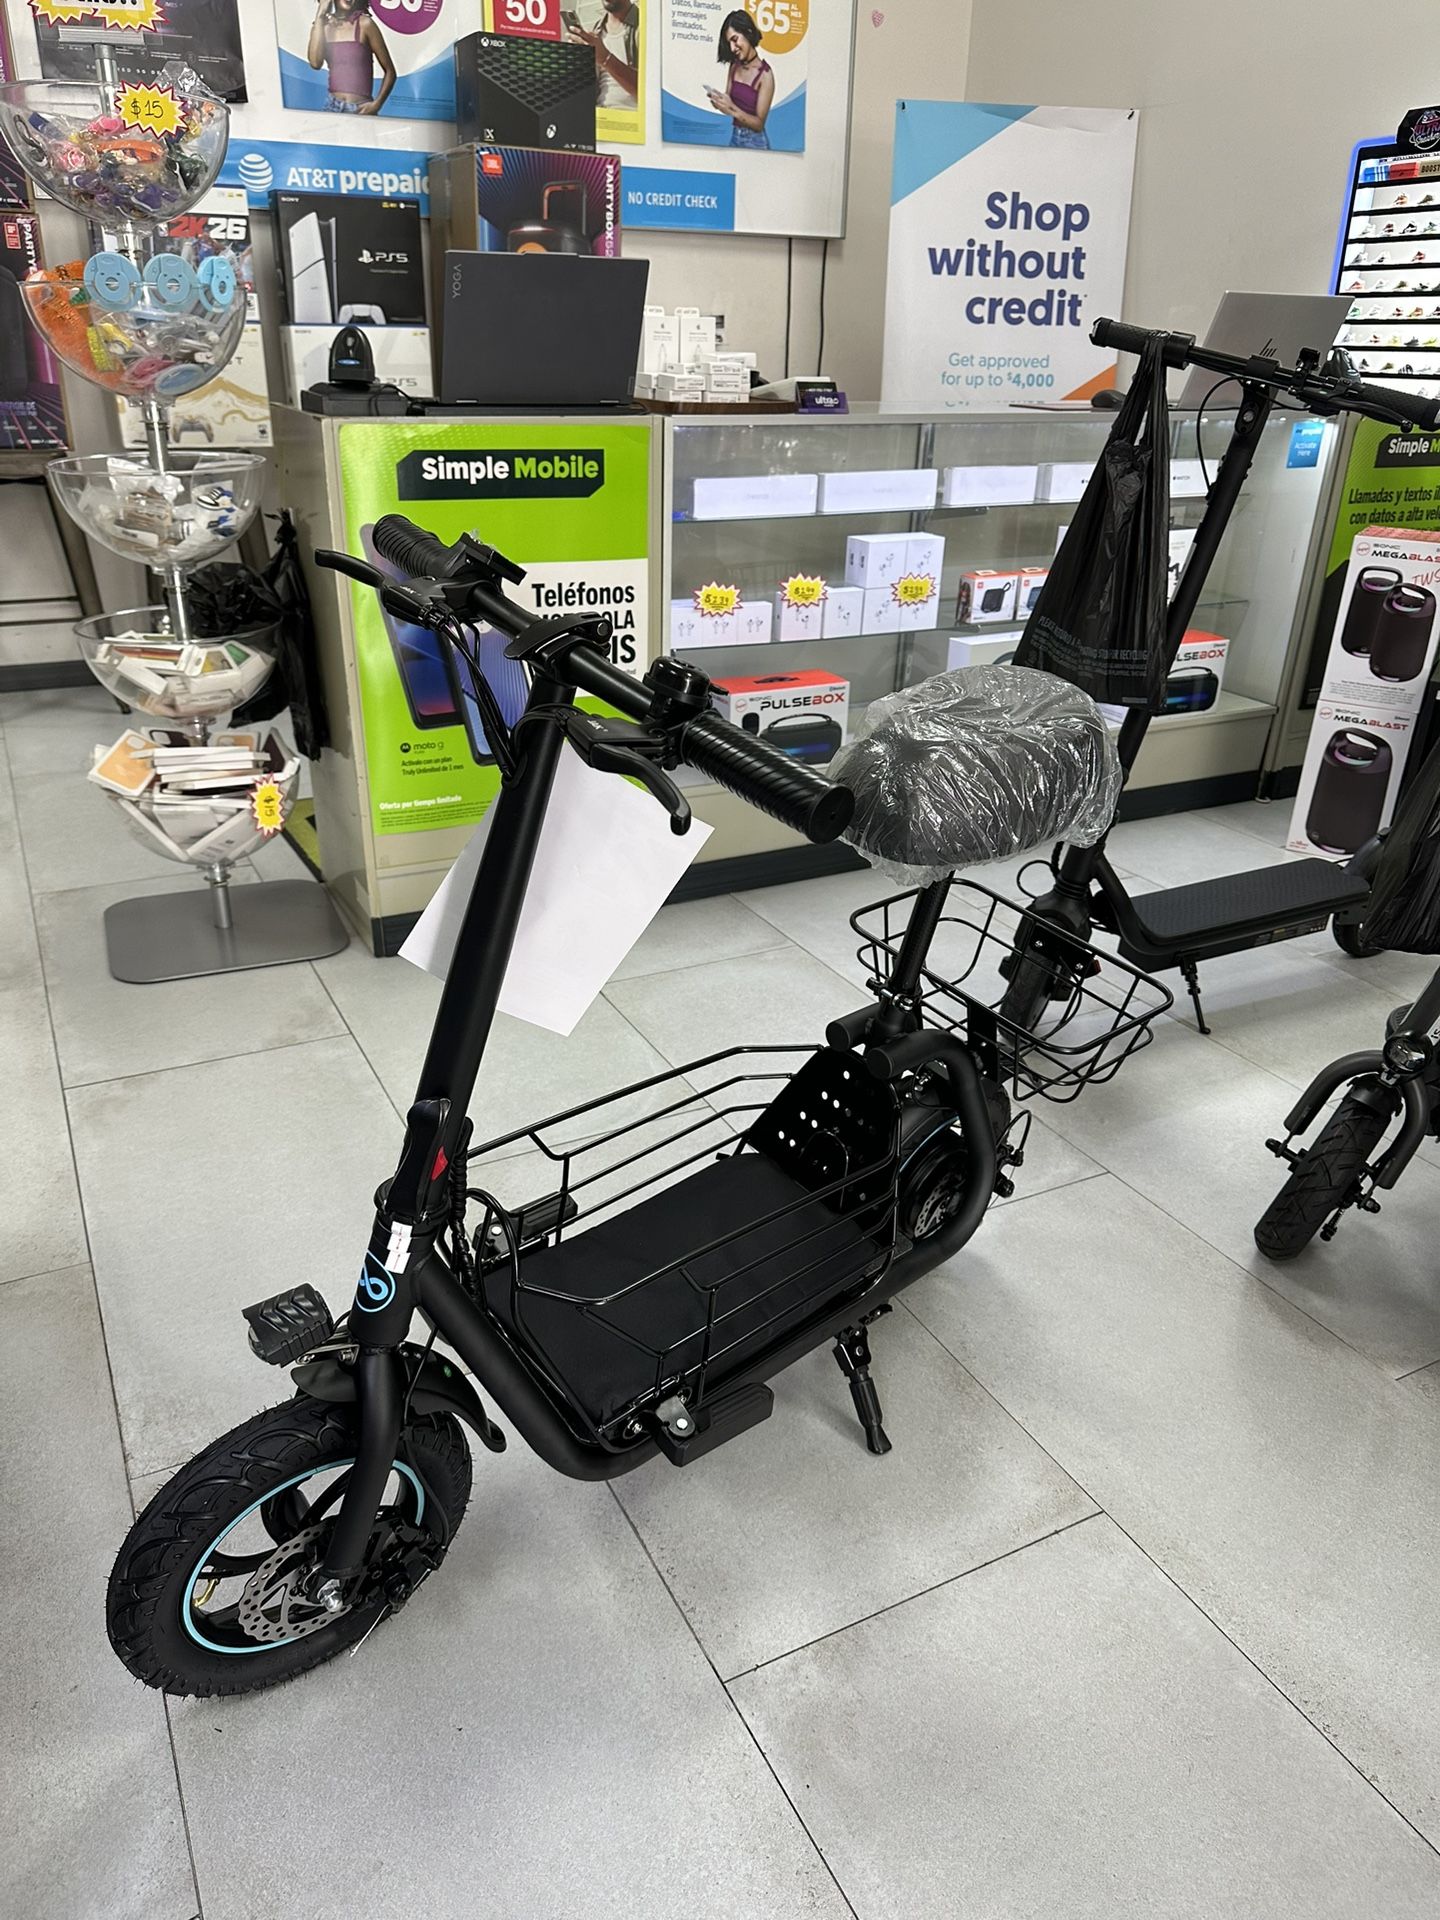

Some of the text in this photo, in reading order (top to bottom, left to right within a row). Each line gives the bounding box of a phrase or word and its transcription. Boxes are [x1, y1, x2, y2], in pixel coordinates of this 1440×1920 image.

[130, 100, 163, 119] $15
[287, 167, 334, 189] AT&T
[627, 191, 718, 209] NO CREDIT CHECK
[984, 191, 1090, 241] Shop
[375, 251, 409, 264] PS5
[927, 237, 1087, 280] without
[452, 264, 463, 299] YOGA
[964, 288, 1082, 327] credit
[948, 352, 1050, 370] Get approved
[941, 371, 1055, 389] for up to $4,000
[1388, 437, 1430, 457] Simple
[421, 454, 599, 484] Simple Mobile
[1349, 487, 1394, 505] Llamadas
[1394, 490, 1402, 506] y
[1404, 486, 1432, 502] textos
[1350, 510, 1366, 525] con
[1369, 507, 1396, 524] datos
[1398, 510, 1405, 522] a
[1406, 507, 1424, 522] alta
[531, 581, 635, 608] Teléfonos
[760, 692, 845, 711] PULSEBOX
[1333, 714, 1409, 731] MEGABLAST
[413, 742, 436, 750] moto
